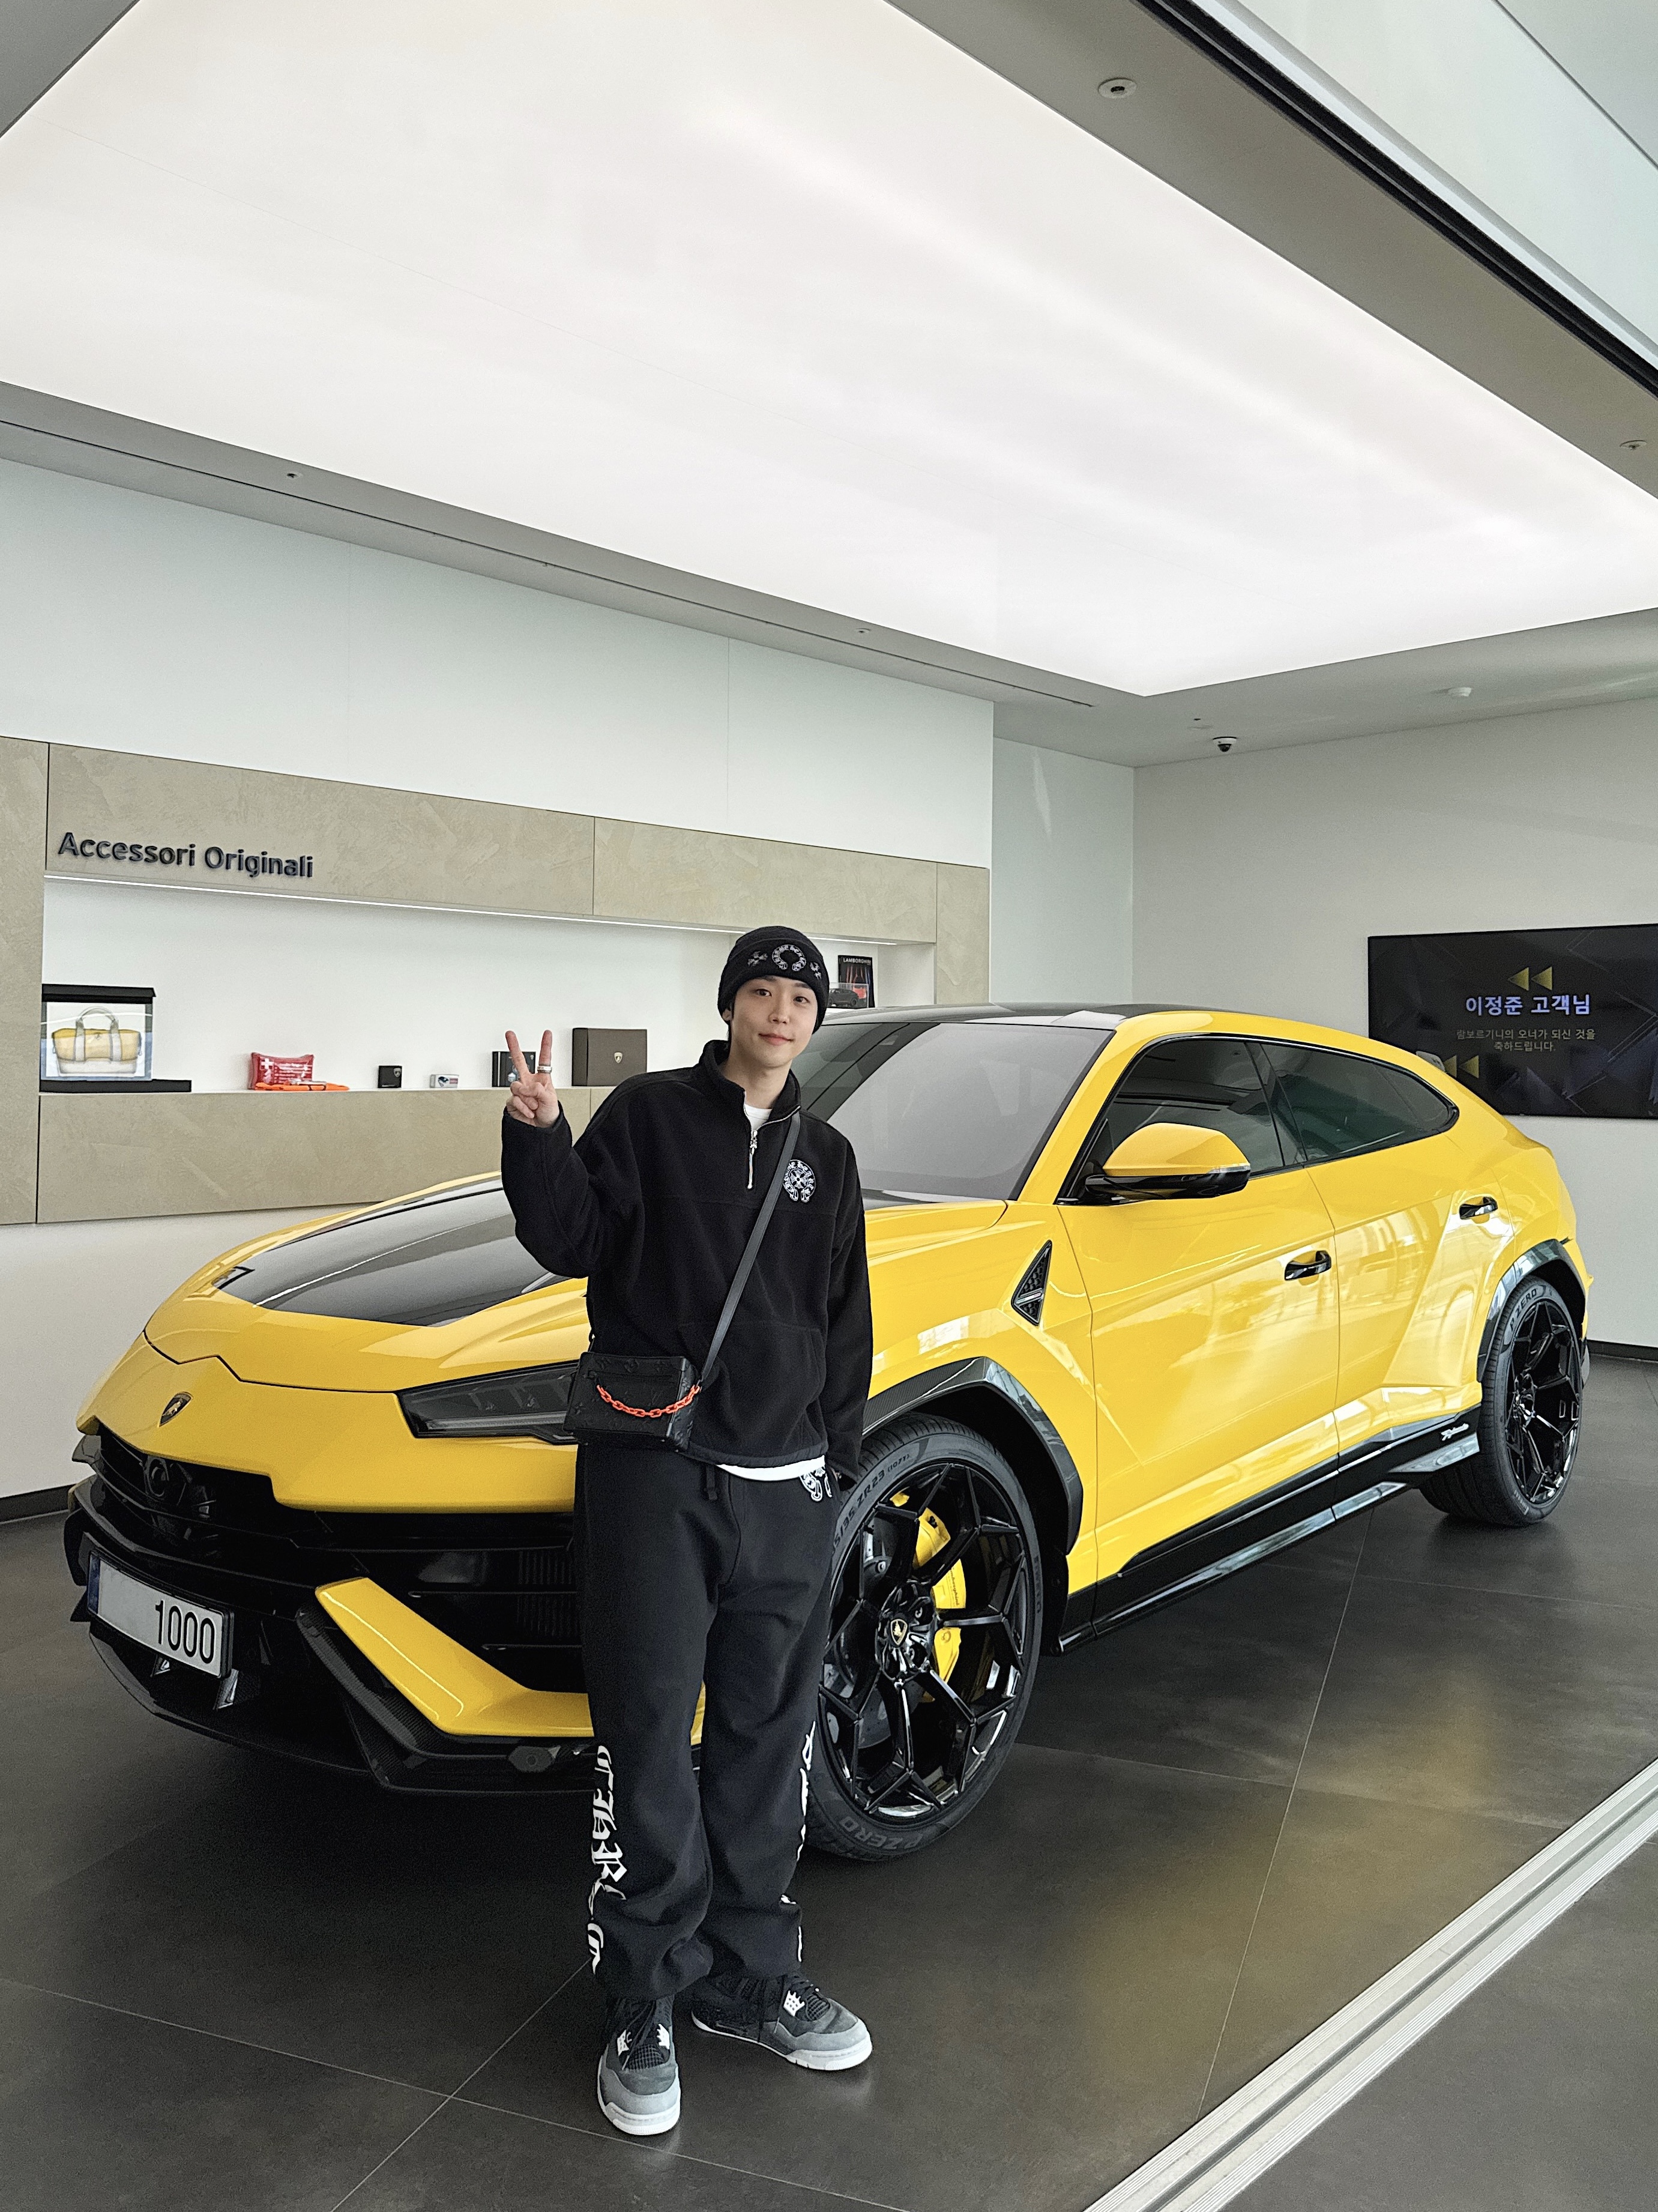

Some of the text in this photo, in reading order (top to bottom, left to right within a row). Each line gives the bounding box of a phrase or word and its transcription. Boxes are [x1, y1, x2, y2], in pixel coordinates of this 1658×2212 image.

[58, 832, 313, 878] Accessori Originali
[1466, 994, 1590, 1016] 이정준 고객님
[1456, 1029, 1596, 1040] 람보르기니의 오너가 되신 것을
[1494, 1041, 1556, 1052] 축하드립니다.
[1515, 1288, 1537, 1319] ZERO
[834, 1506, 855, 1548] 5/35
[155, 1600, 216, 1664] 1000
[839, 1816, 903, 1850] ZERO
